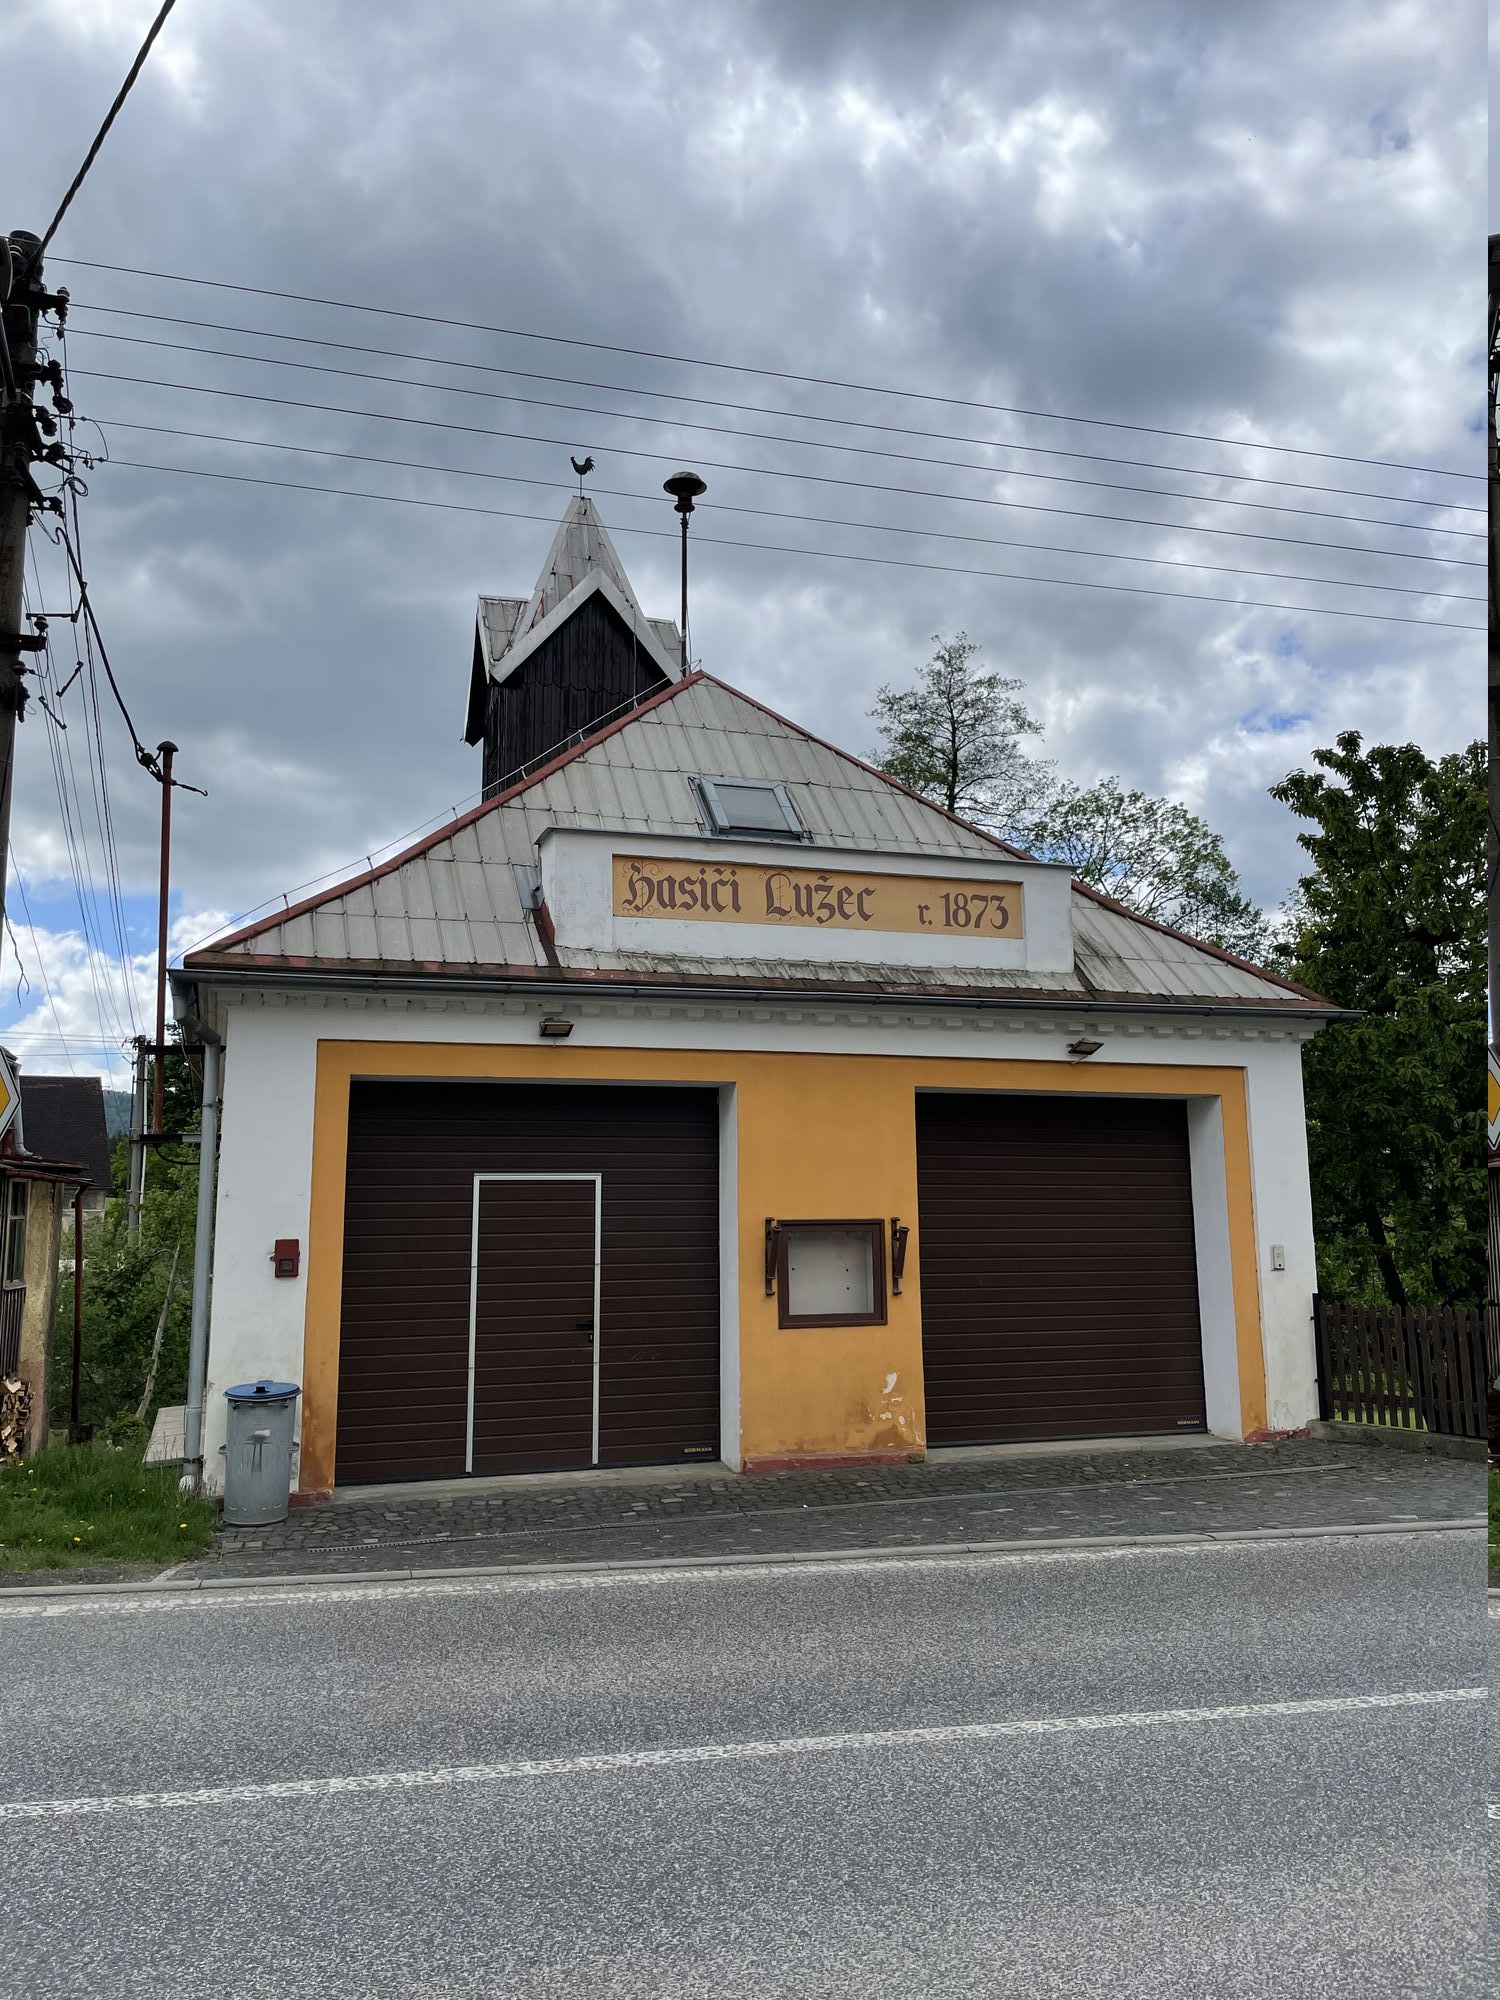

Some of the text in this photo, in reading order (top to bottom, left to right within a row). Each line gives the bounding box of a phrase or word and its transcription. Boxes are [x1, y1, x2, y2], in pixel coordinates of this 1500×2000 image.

[622, 862, 1009, 930] Hasiči Lužec r. 1873
